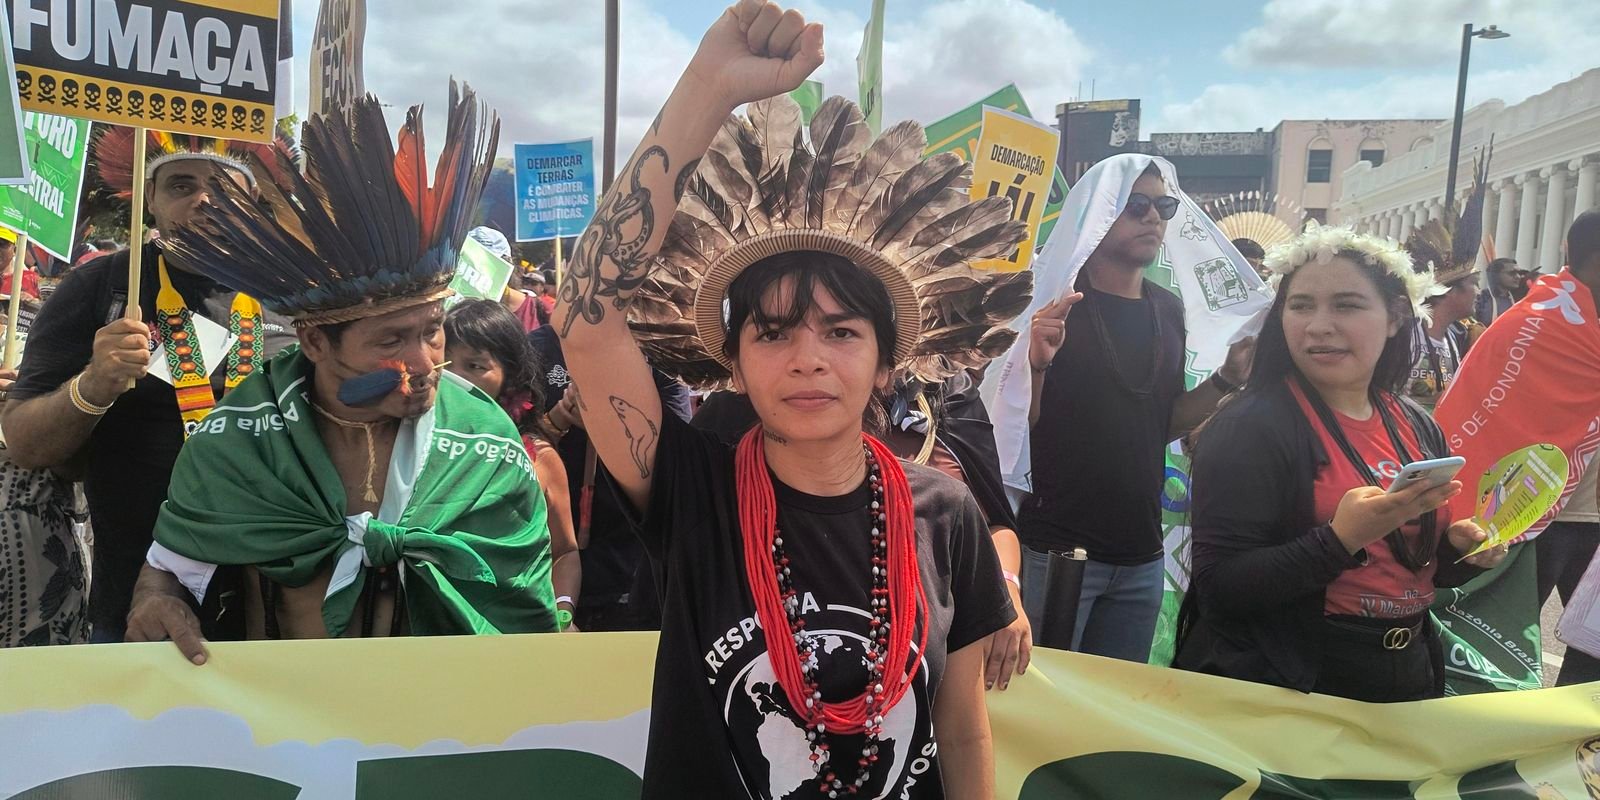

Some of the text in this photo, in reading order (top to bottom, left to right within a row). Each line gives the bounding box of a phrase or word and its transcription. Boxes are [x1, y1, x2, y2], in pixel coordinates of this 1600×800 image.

[13, 0, 269, 94] FUMAÇA
[527, 154, 583, 169] DEMARCAR
[990, 143, 1045, 177] DEMARCAÇÃO
[536, 169, 574, 184] TERRAS
[528, 181, 583, 196] É COMBATER
[523, 194, 589, 210] AS MUDANÇAS
[1461, 411, 1488, 436] DE
[1481, 315, 1545, 415] RONDÔNIA
